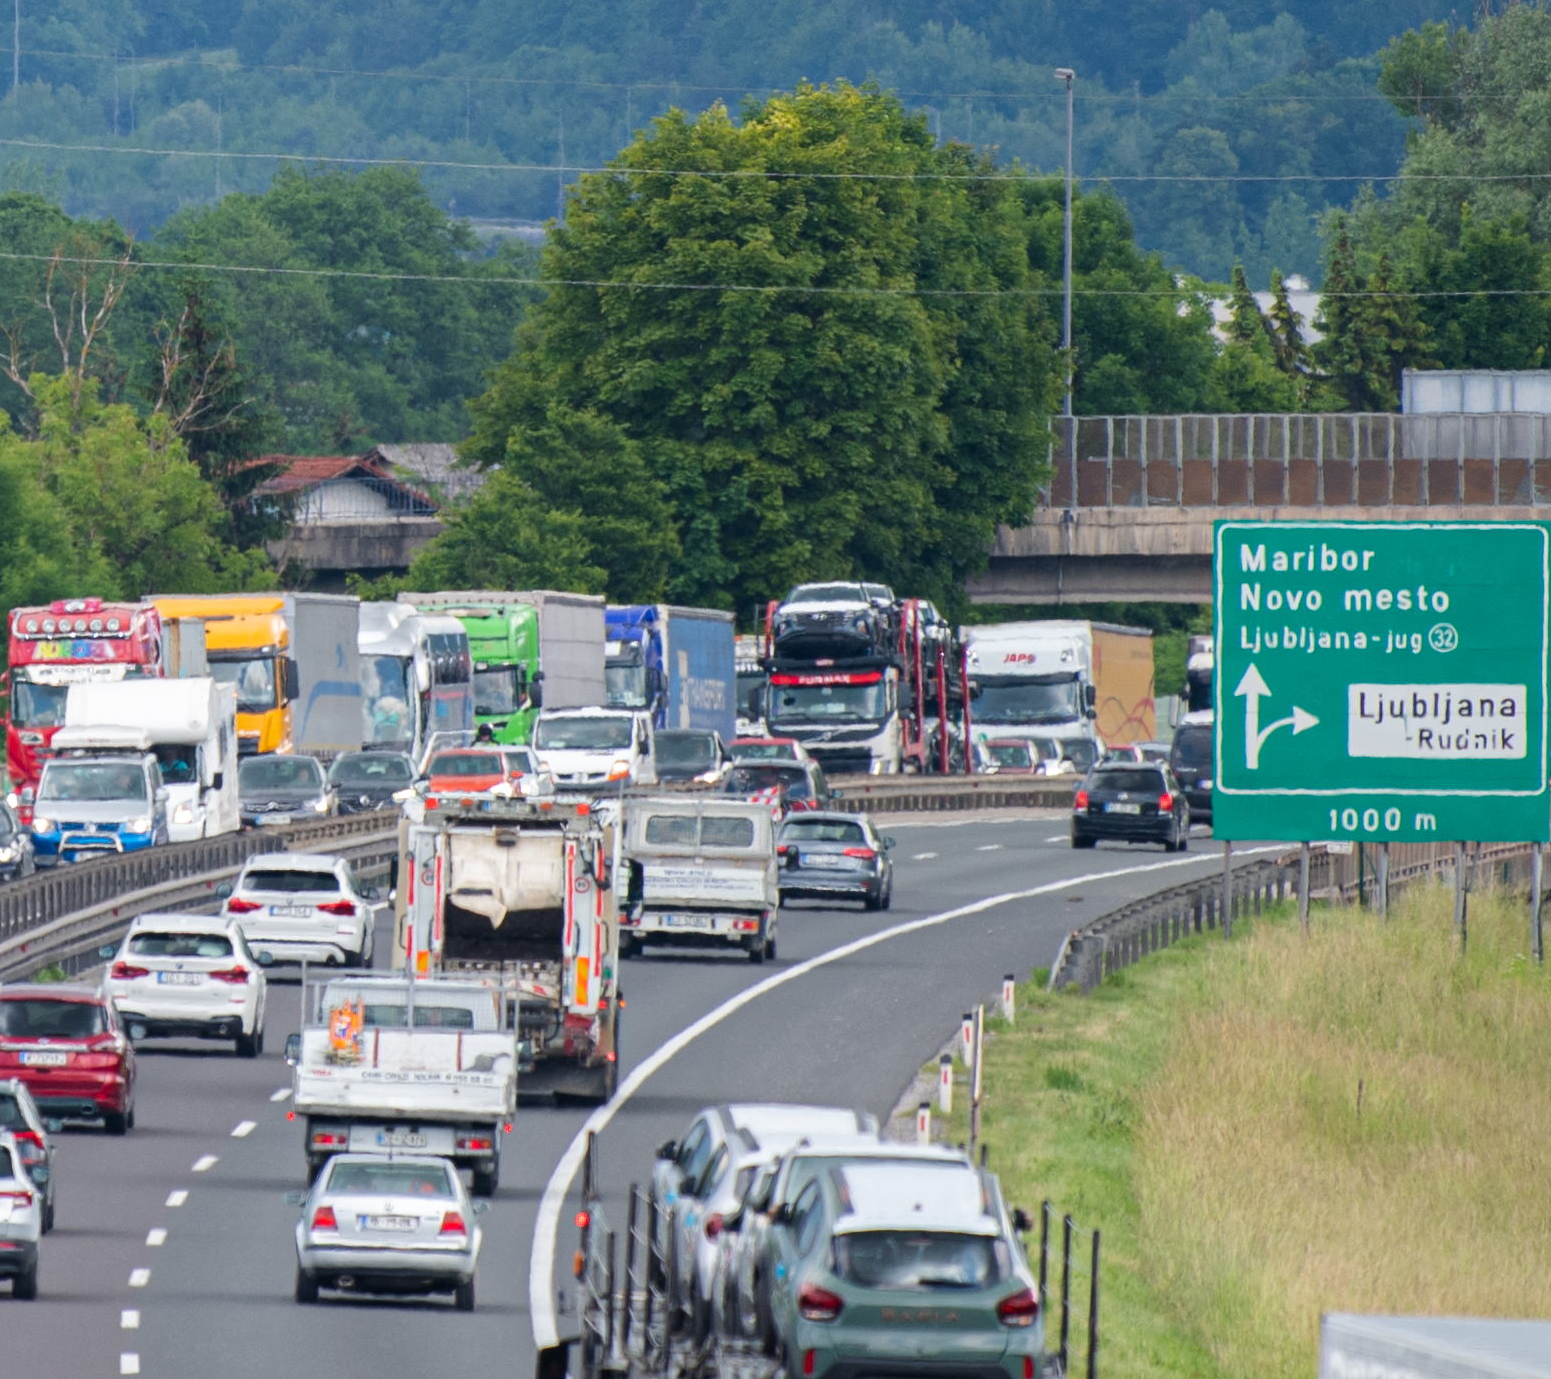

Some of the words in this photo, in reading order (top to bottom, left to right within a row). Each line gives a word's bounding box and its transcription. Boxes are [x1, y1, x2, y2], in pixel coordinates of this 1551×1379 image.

[1240, 543, 1375, 572] Maribor
[1240, 582, 1323, 611] Novo
[1344, 585, 1450, 612] mesto
[1240, 625, 1423, 654] Ljubljana-jug
[1434, 629, 1454, 648] 32
[1359, 691, 1517, 724] Ljubljana
[1329, 807, 1401, 832] 1000
[1414, 812, 1437, 831] m
